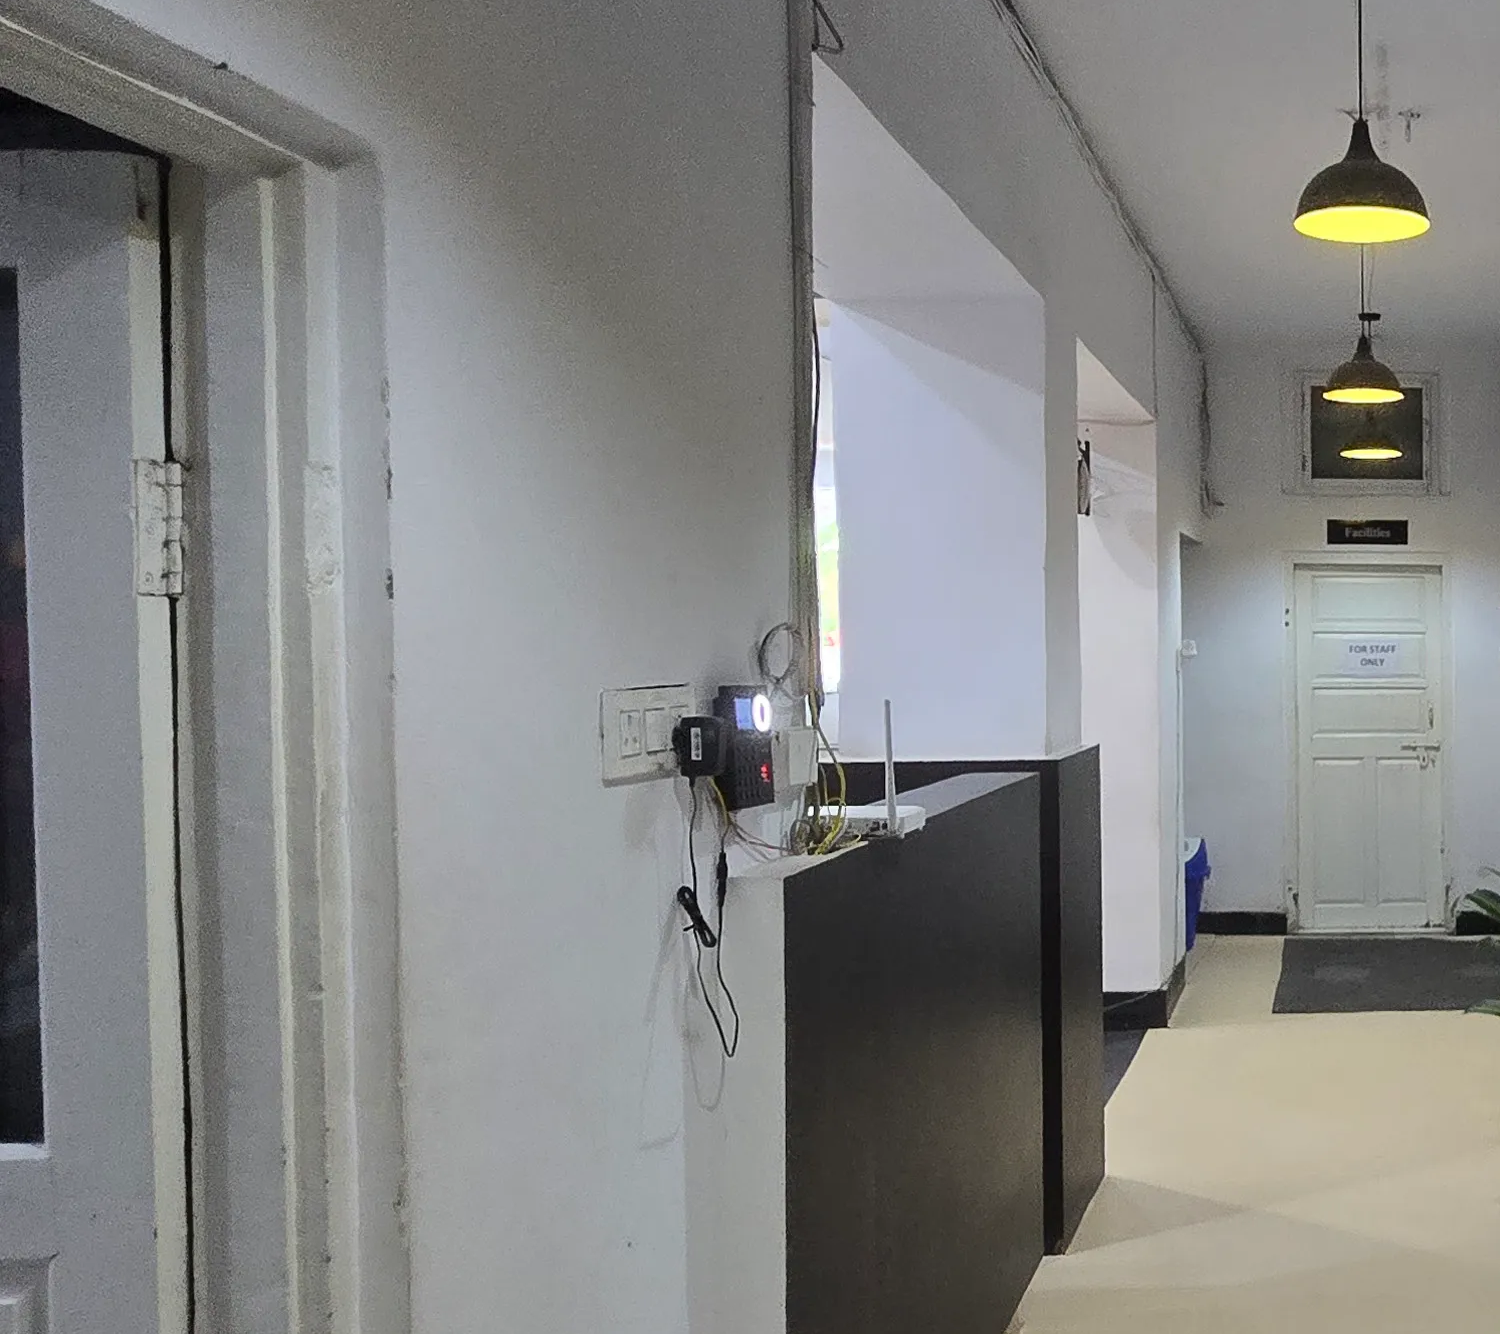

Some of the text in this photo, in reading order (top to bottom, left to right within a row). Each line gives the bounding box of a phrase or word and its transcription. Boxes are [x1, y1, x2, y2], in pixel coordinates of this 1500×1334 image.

[1349, 644, 1396, 654] FOR STAFF
[1360, 658, 1385, 667] ONLY
